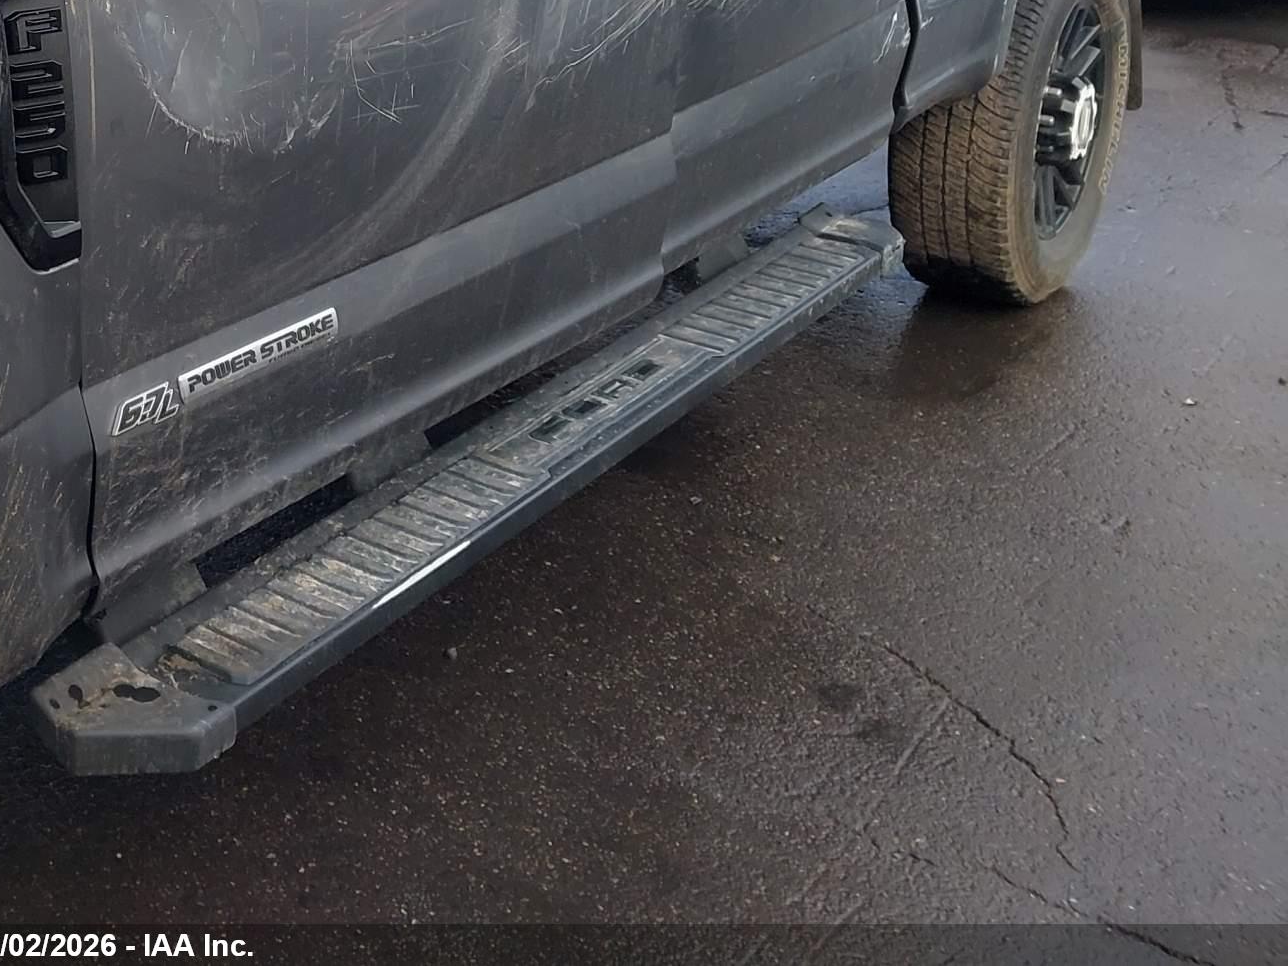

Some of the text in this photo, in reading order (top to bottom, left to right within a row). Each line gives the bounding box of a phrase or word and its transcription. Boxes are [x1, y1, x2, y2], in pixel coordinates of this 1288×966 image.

[1097, 42, 1129, 195] MICHELIN
[187, 350, 258, 393] POWER
[260, 313, 335, 359] STROKE
